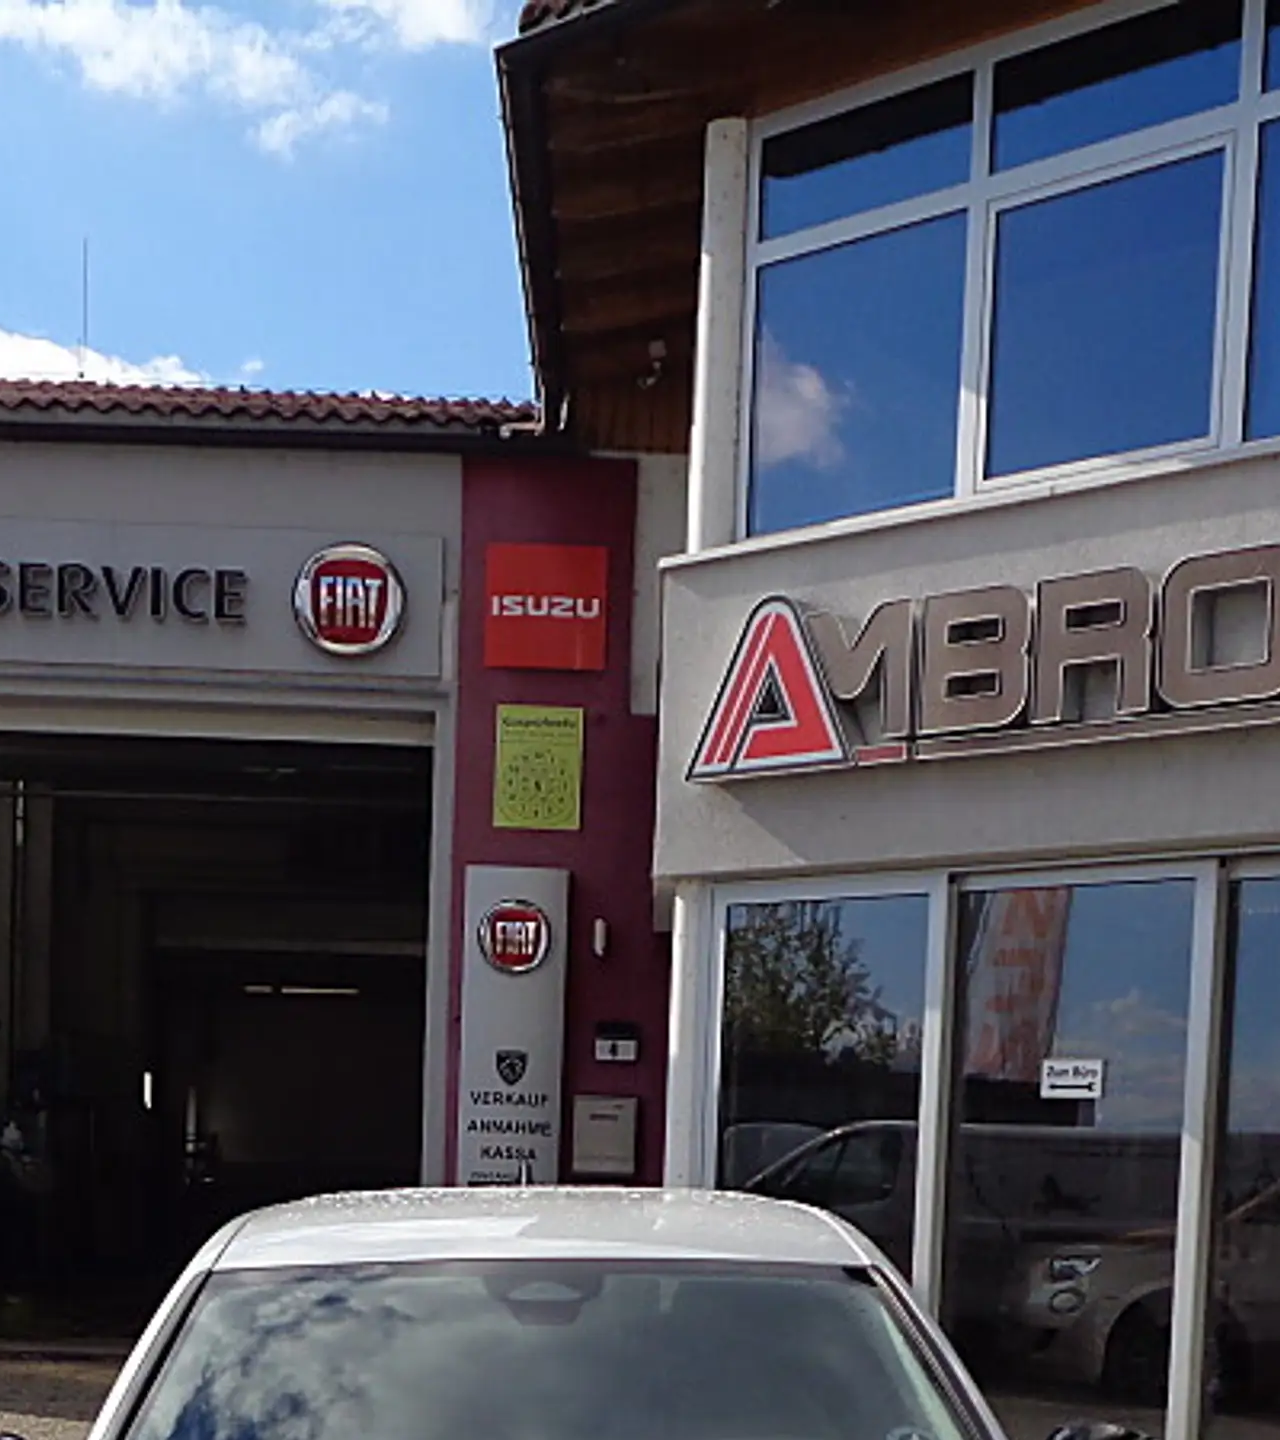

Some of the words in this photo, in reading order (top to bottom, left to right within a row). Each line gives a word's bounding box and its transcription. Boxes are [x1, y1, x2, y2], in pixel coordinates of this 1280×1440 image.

[320, 576, 382, 629] FIAT
[491, 595, 600, 618] ISUZU
[495, 921, 537, 955] FIAT
[470, 1090, 548, 1108] VERKAUF
